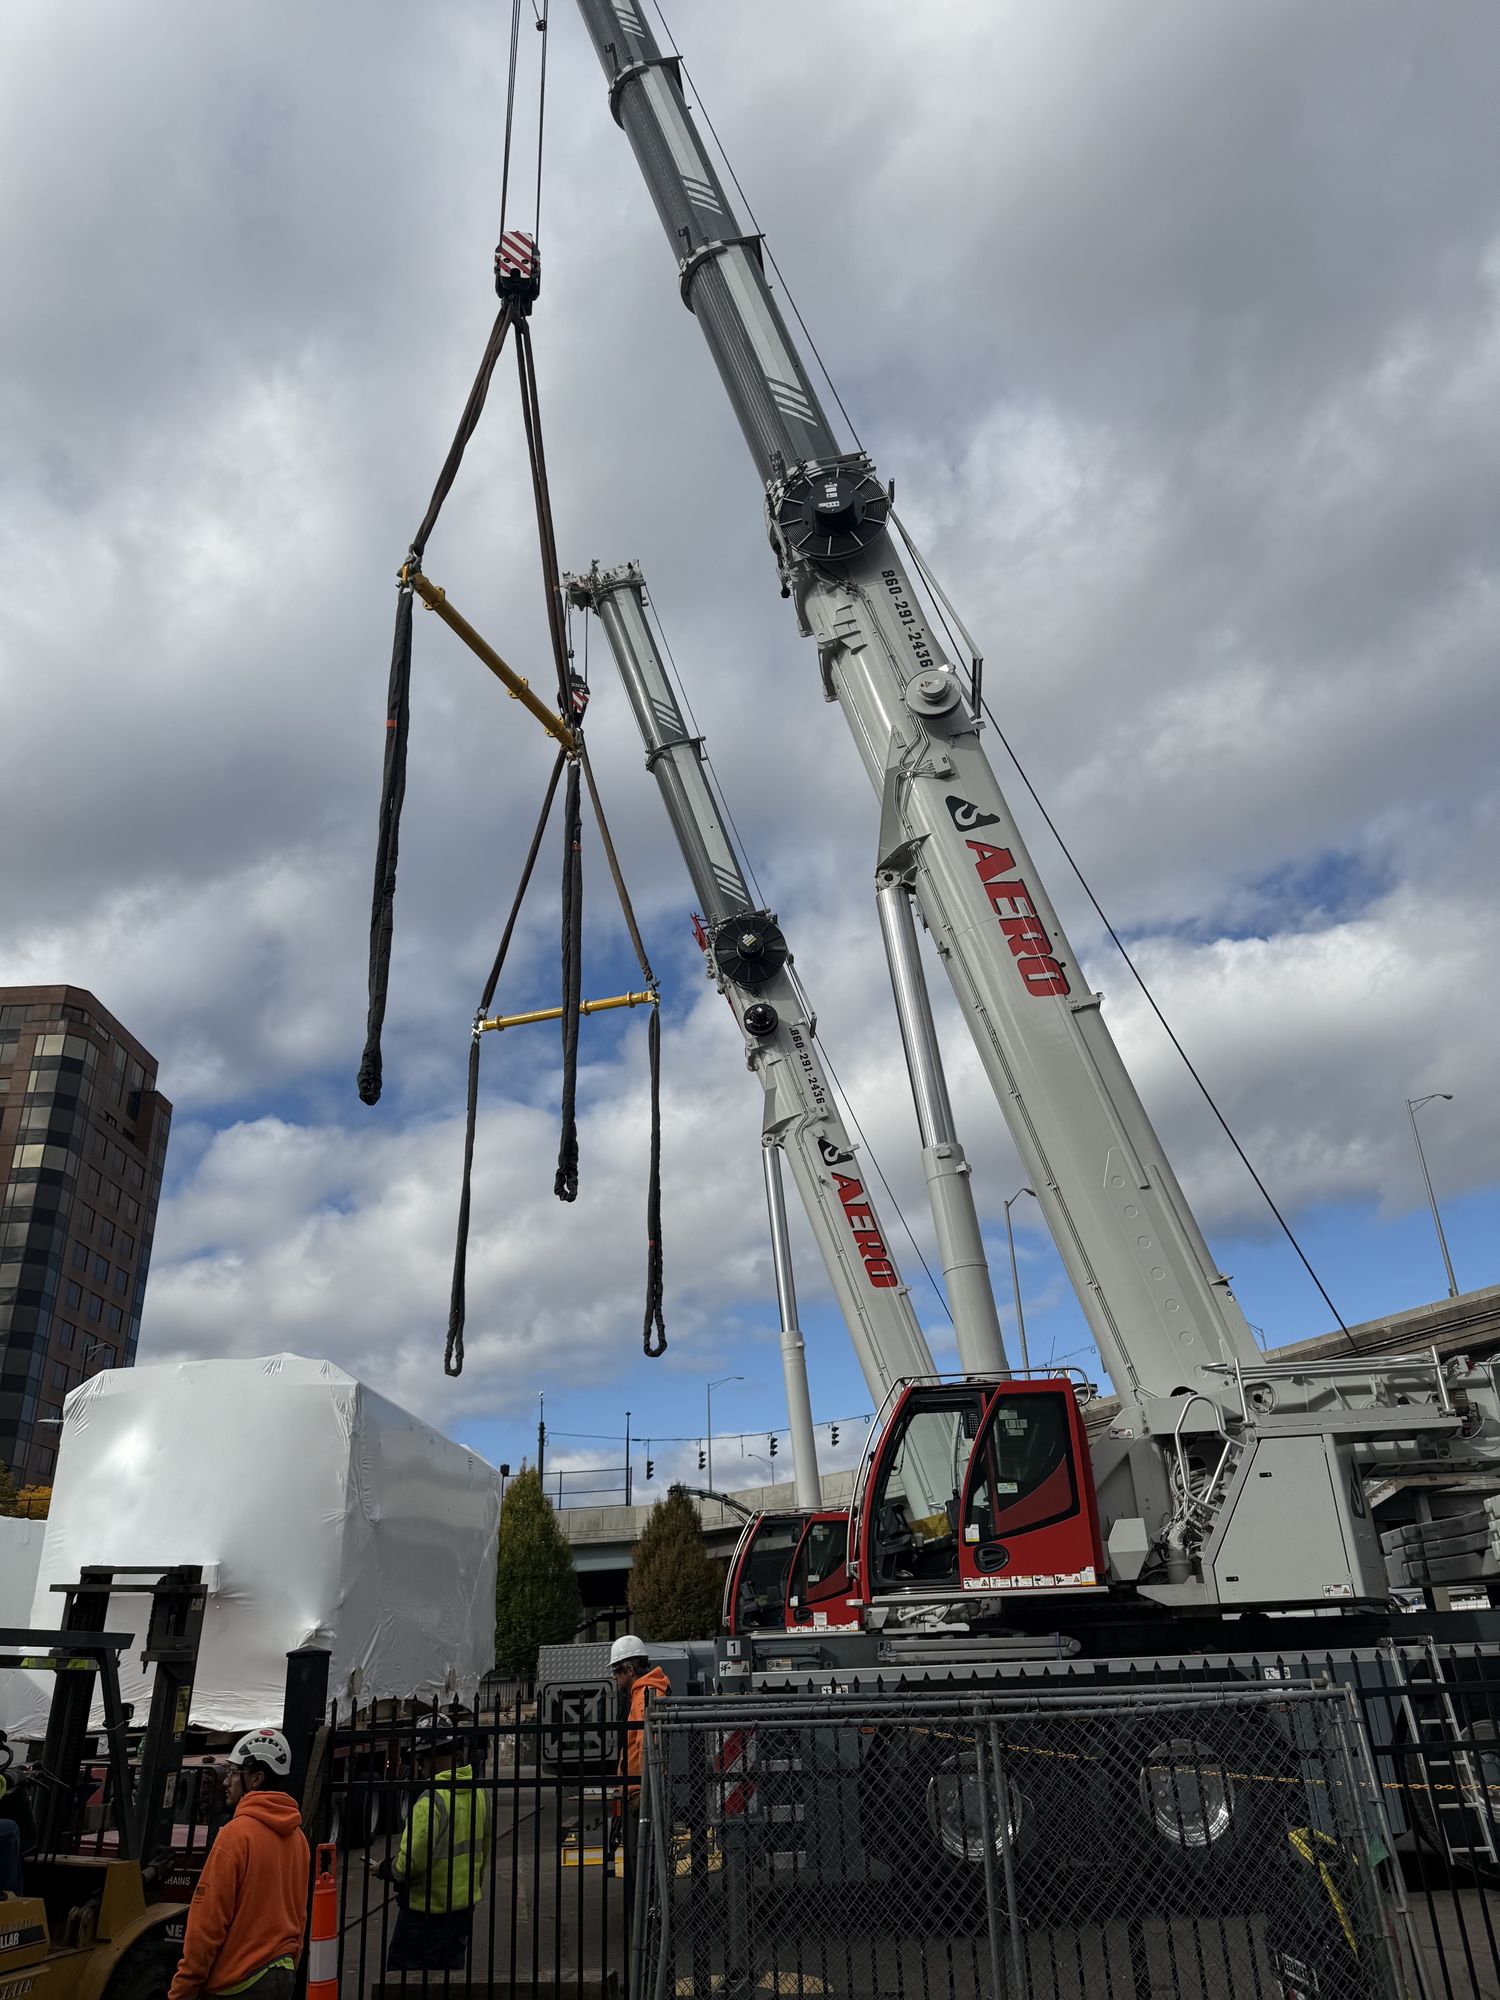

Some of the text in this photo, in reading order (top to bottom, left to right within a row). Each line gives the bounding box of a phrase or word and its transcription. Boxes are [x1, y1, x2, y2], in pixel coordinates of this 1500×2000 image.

[881, 569, 934, 668] 860-291-2436
[965, 839, 1071, 998] AERO
[790, 1028, 826, 1104] 860-291-2436
[831, 1172, 899, 1289] AERO
[730, 1642, 736, 1654] 1
[164, 1875, 191, 1886] HAINS
